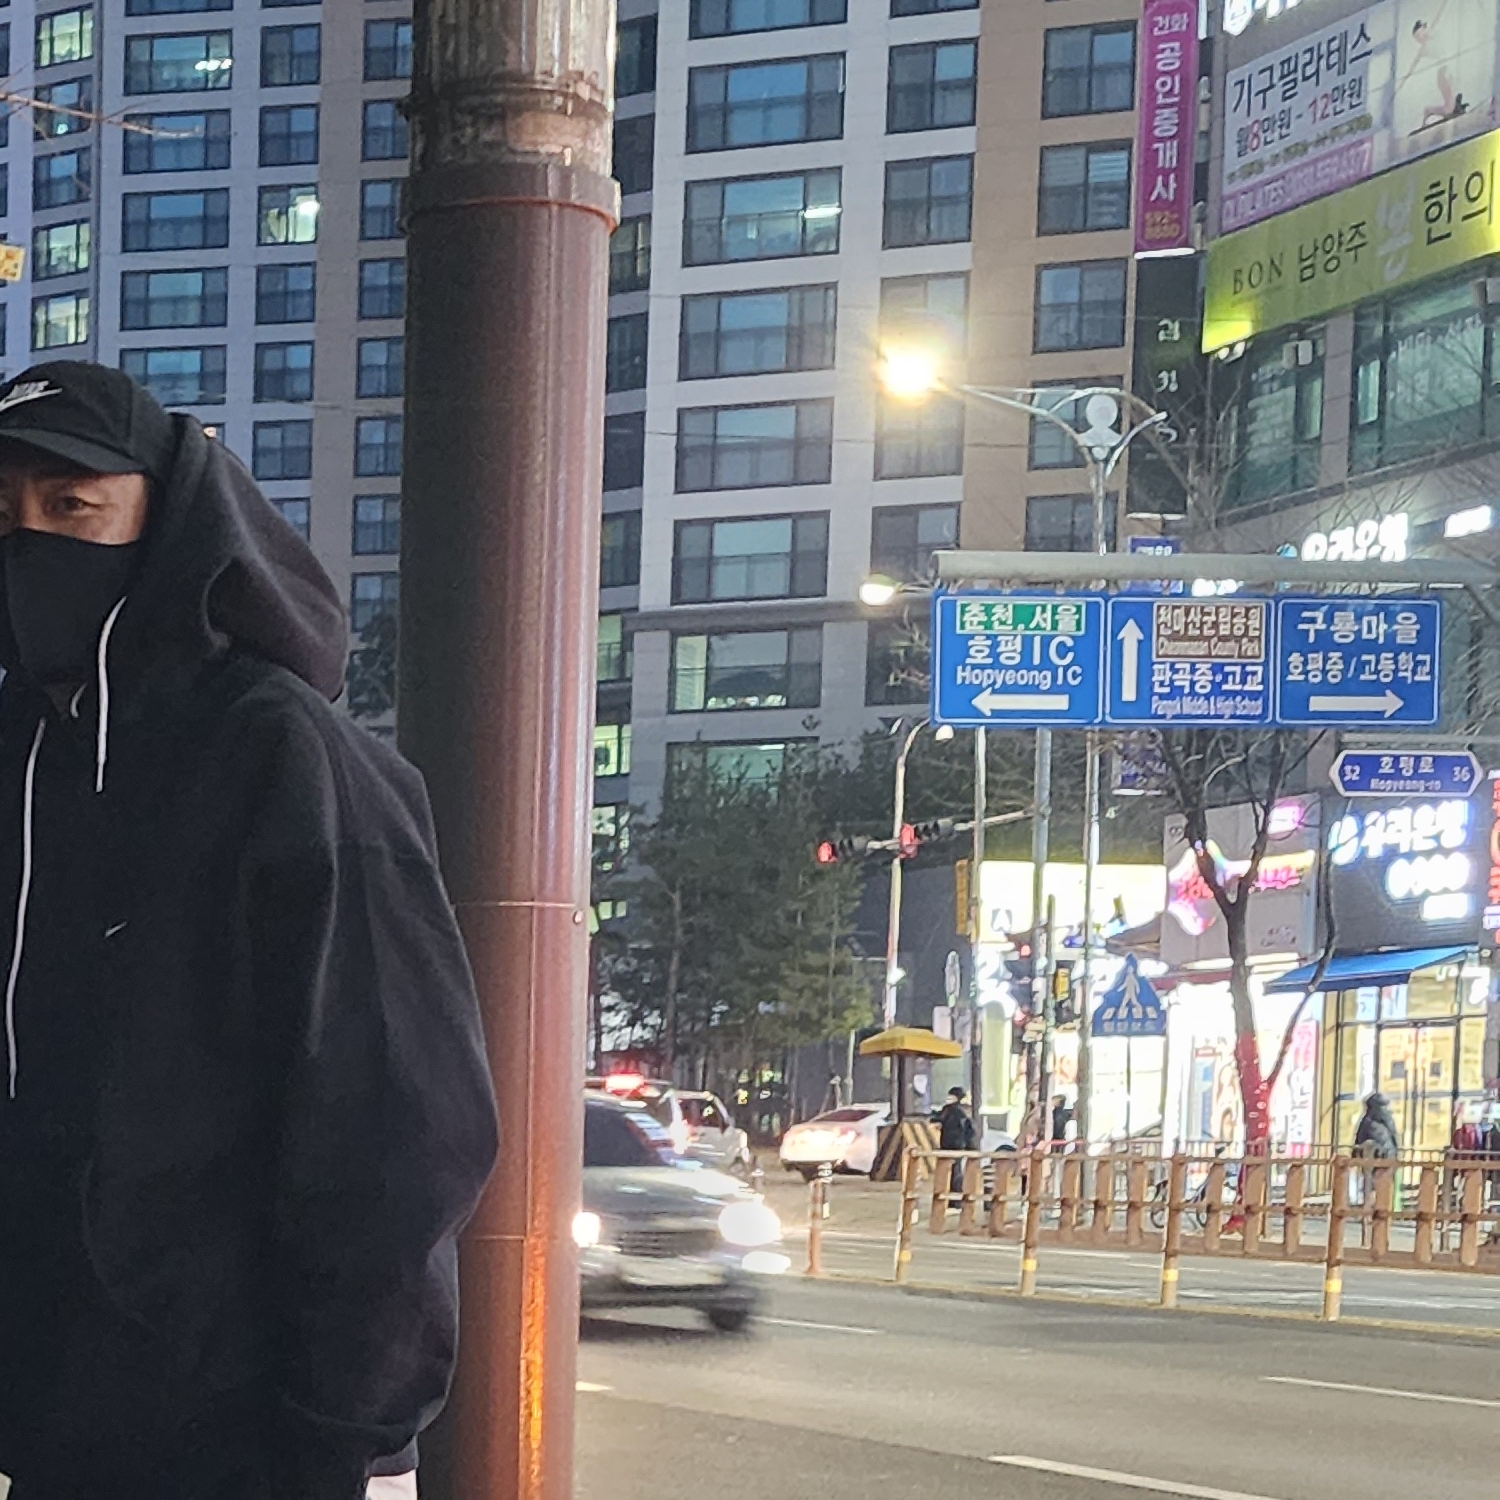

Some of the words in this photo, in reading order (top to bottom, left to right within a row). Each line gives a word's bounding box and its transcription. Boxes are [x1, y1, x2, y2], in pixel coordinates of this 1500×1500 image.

[1233, 22, 1373, 118] 기구필라테스
[1308, 76, 1363, 126] 12만원
[1150, 41, 1183, 203] 공인중개사
[1233, 252, 1284, 295] BON
[1298, 221, 1368, 283] 남양주
[1157, 605, 1261, 637] 천마산군립공원
[1297, 611, 1421, 645] 구룡마을
[956, 665, 1052, 690] Hopyeong
[1057, 665, 1083, 686] IC
[1378, 756, 1435, 776] 호평로
[1452, 766, 1471, 782] 36
